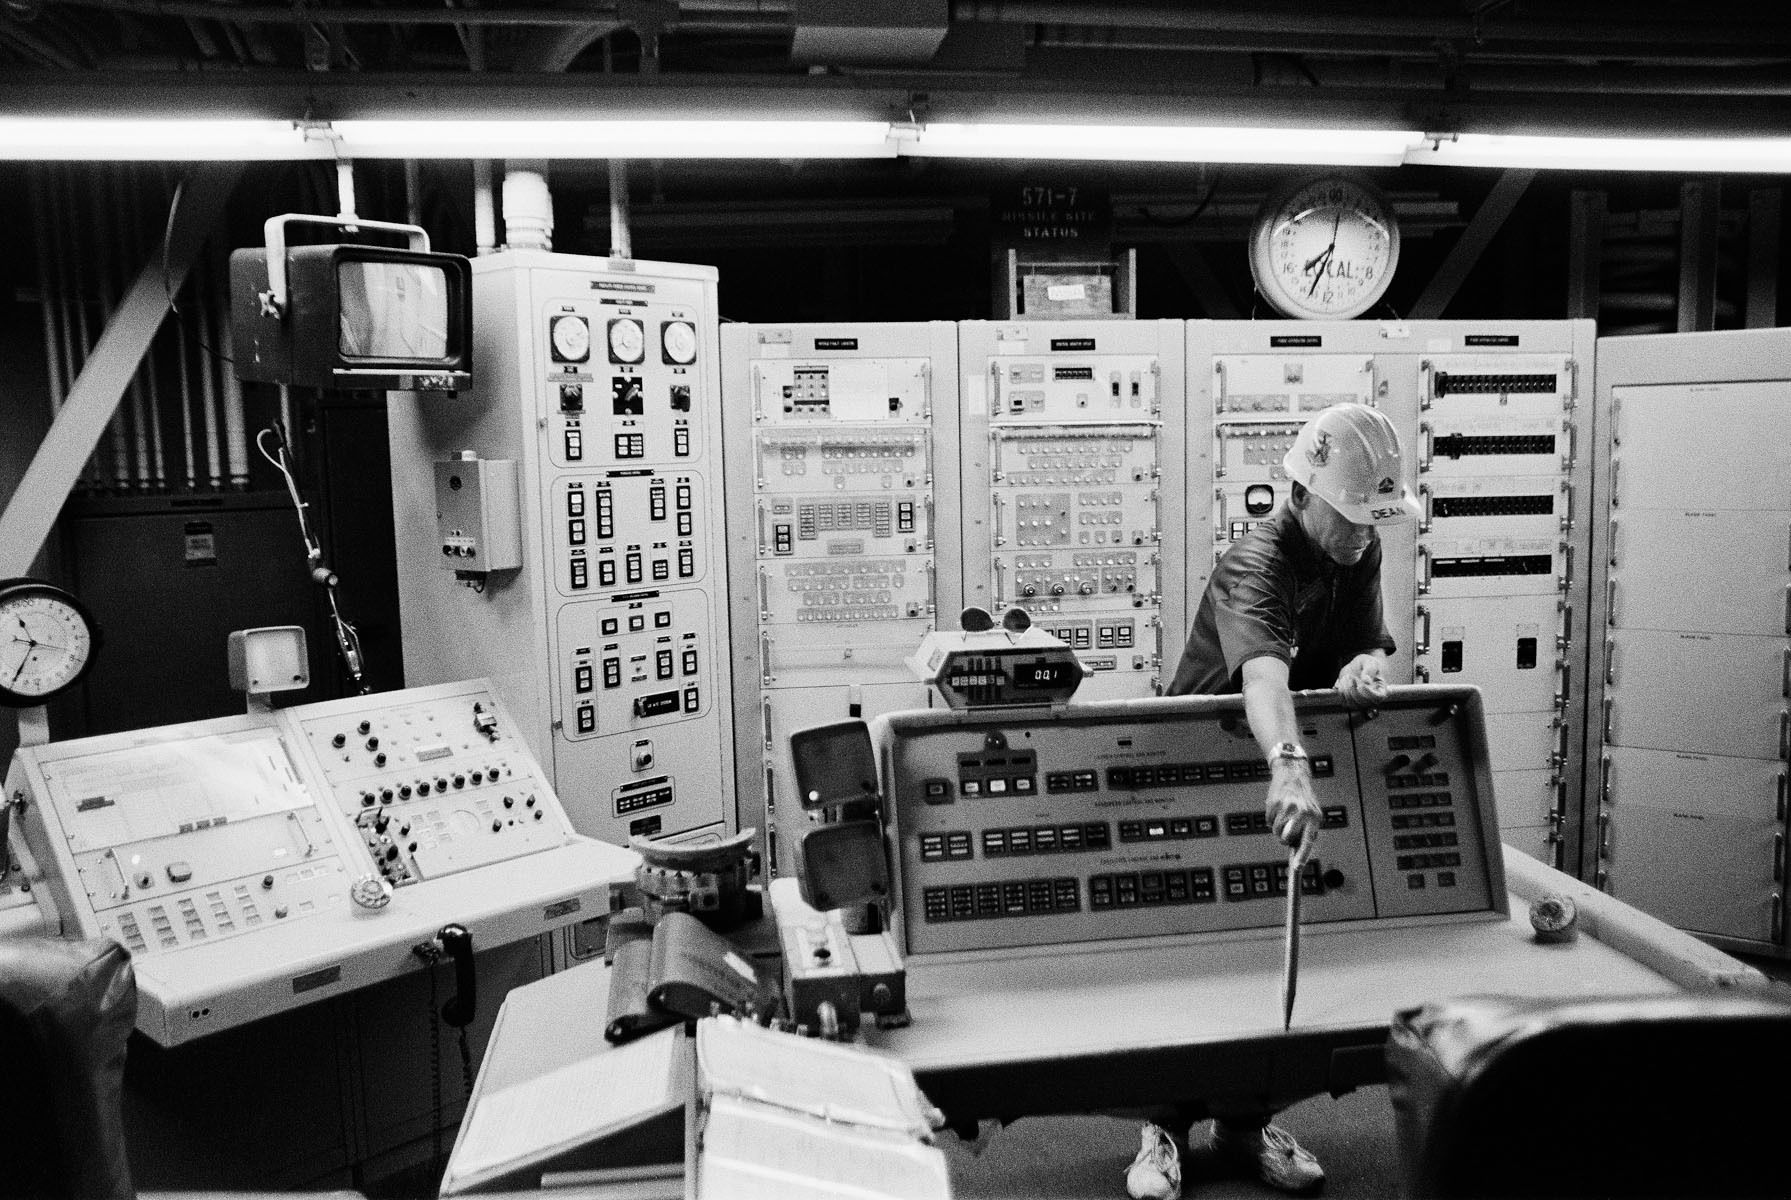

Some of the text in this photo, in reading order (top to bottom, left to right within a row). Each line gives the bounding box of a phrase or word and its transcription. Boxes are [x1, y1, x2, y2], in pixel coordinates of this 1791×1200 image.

[1023, 187, 1078, 205] 571-7
[1024, 227, 1078, 237] STATUS
[1283, 259, 1373, 280] 16 LOCAL 8
[1322, 291, 1334, 303] 12
